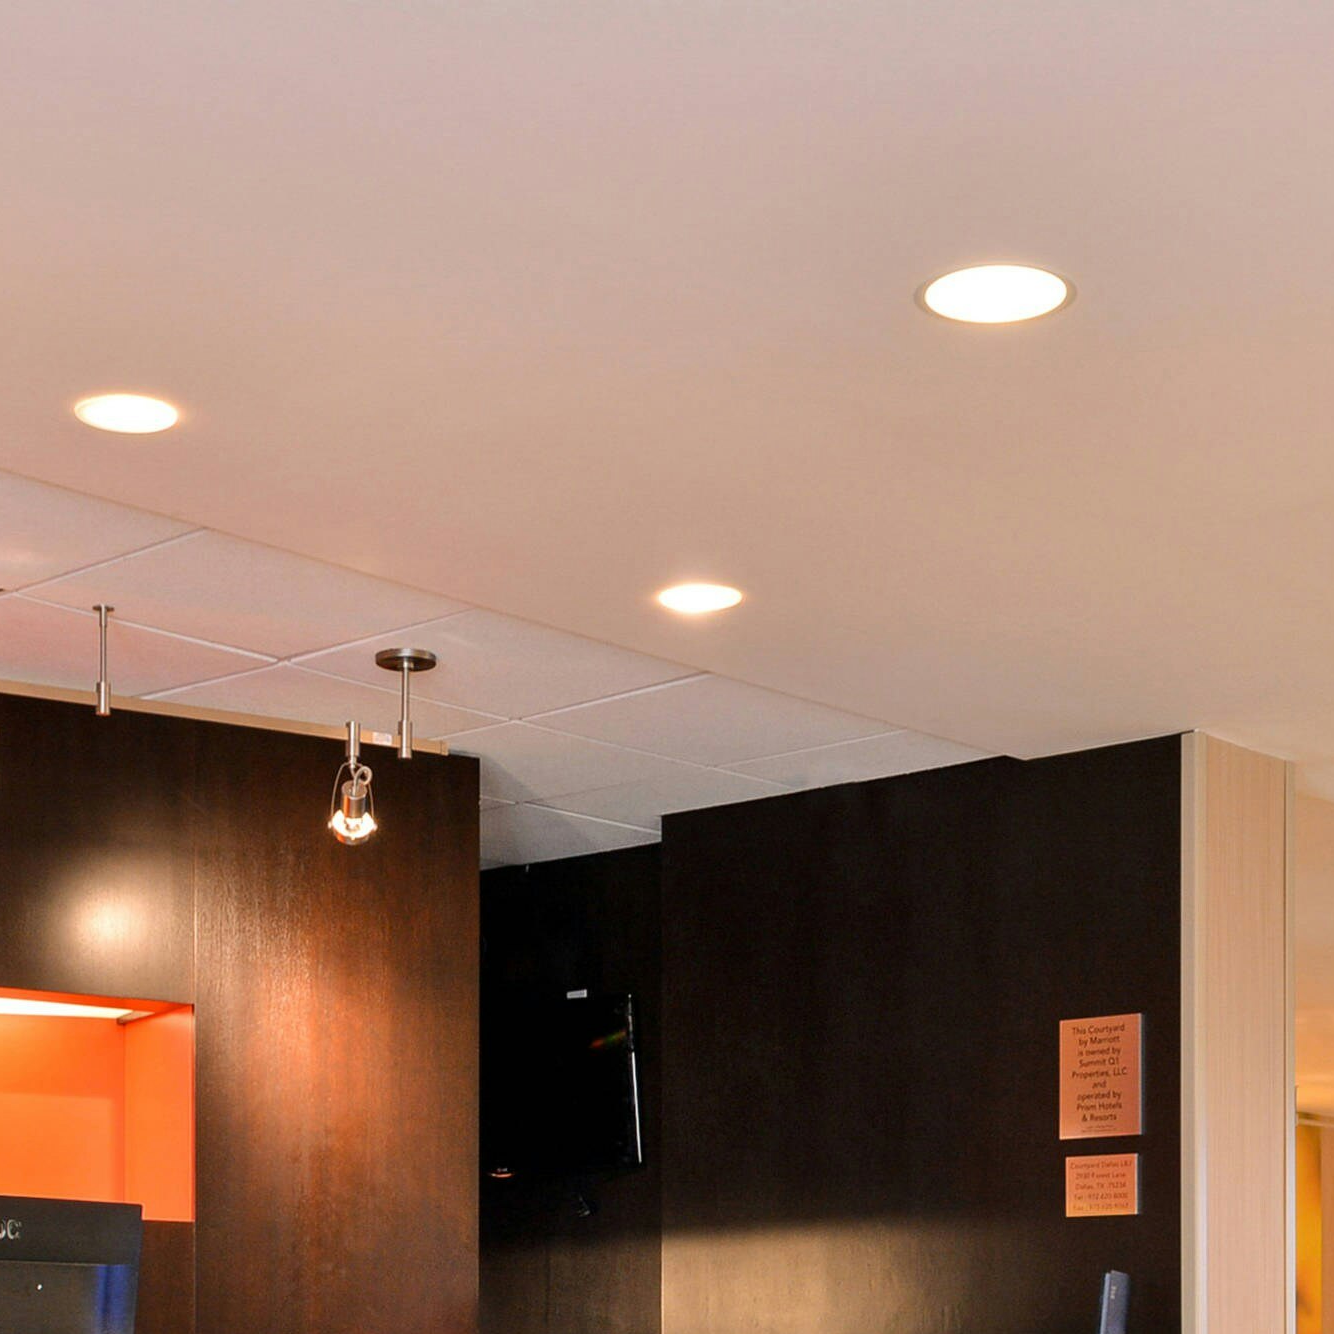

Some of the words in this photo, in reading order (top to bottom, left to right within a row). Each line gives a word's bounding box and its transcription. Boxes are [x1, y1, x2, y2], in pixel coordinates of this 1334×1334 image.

[1088, 1024, 1125, 1036] Courtyard
[1079, 1038, 1088, 1048] by
[1090, 1036, 1120, 1045] Marriott
[1112, 1046, 1121, 1057] by
[1113, 1066, 1127, 1076] LLC
[1092, 1080, 1107, 1089] and
[1077, 1090, 1111, 1102] operated
[1112, 1089, 1122, 1100] by
